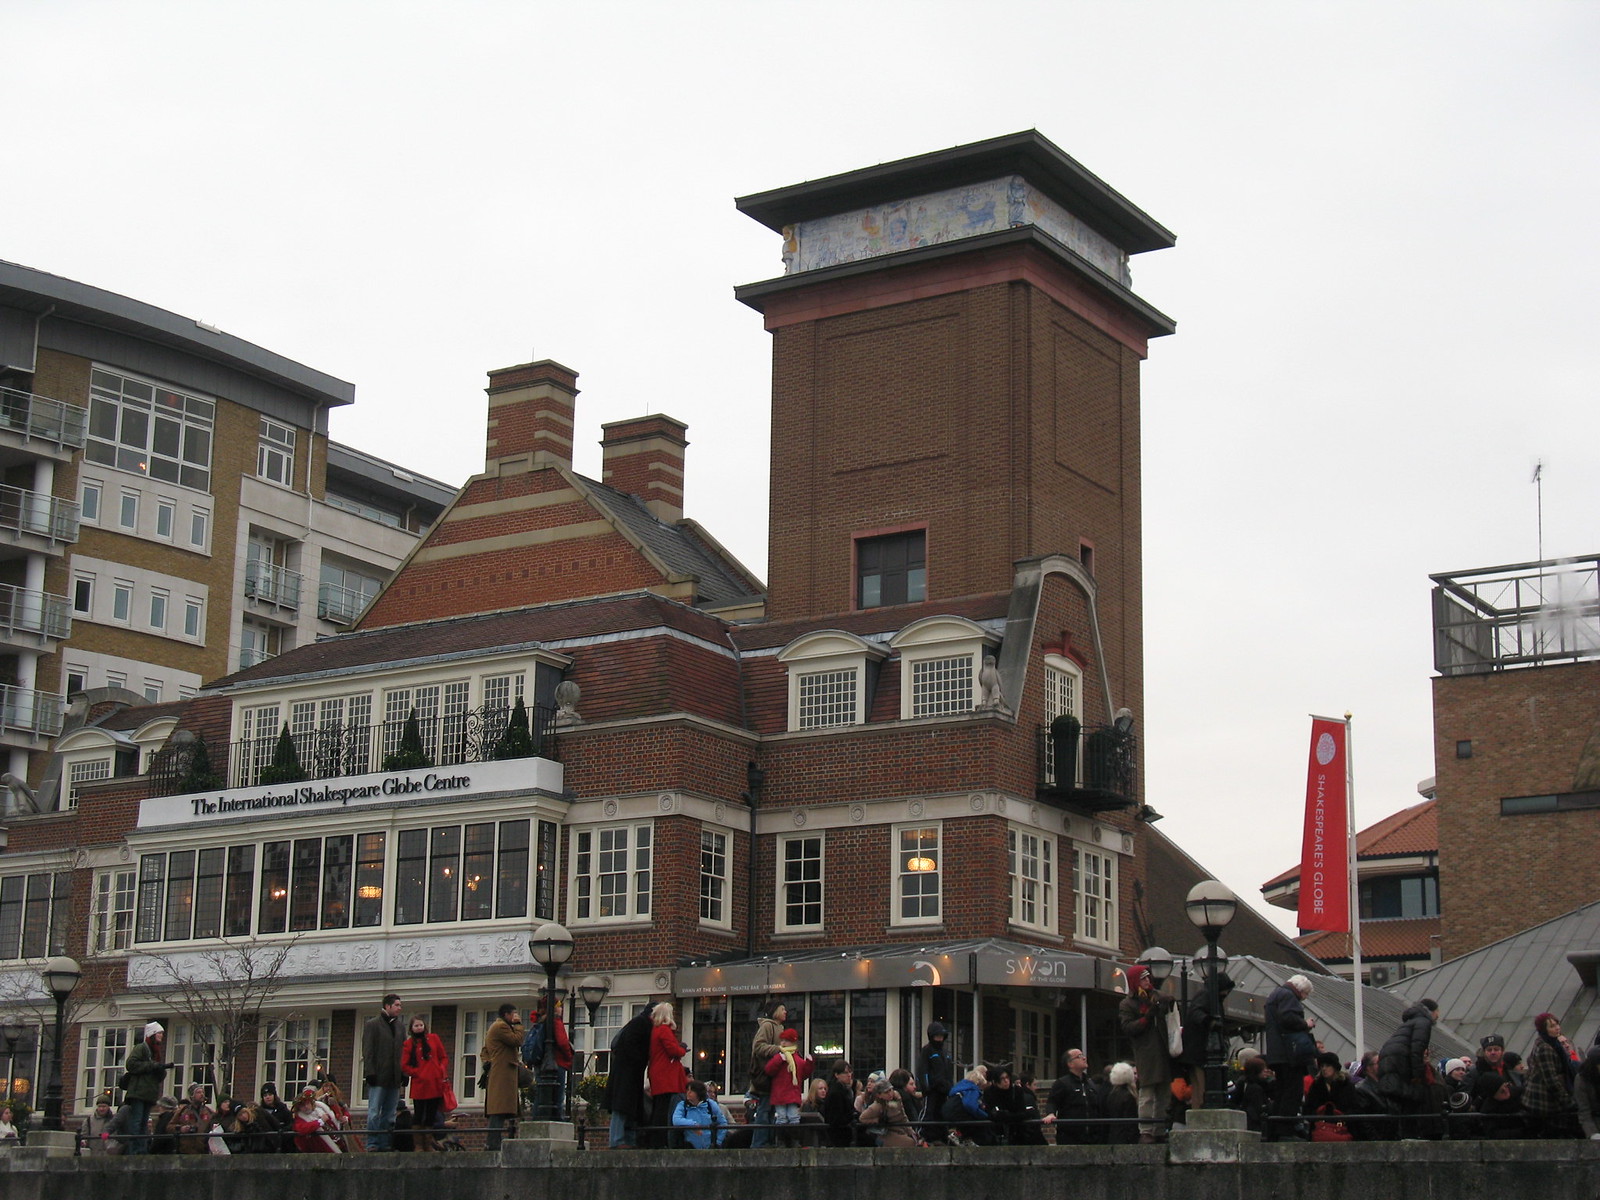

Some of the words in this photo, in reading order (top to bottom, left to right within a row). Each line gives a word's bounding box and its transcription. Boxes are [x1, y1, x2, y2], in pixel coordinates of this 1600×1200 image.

[191, 798, 217, 815] The
[217, 788, 298, 812] International
[298, 785, 380, 805] Shakespeare
[382, 777, 422, 796] Globe
[424, 774, 470, 791] Centre
[1314, 774, 1325, 868] SHAKESPEARE'S
[1313, 872, 1324, 914] GLOBE
